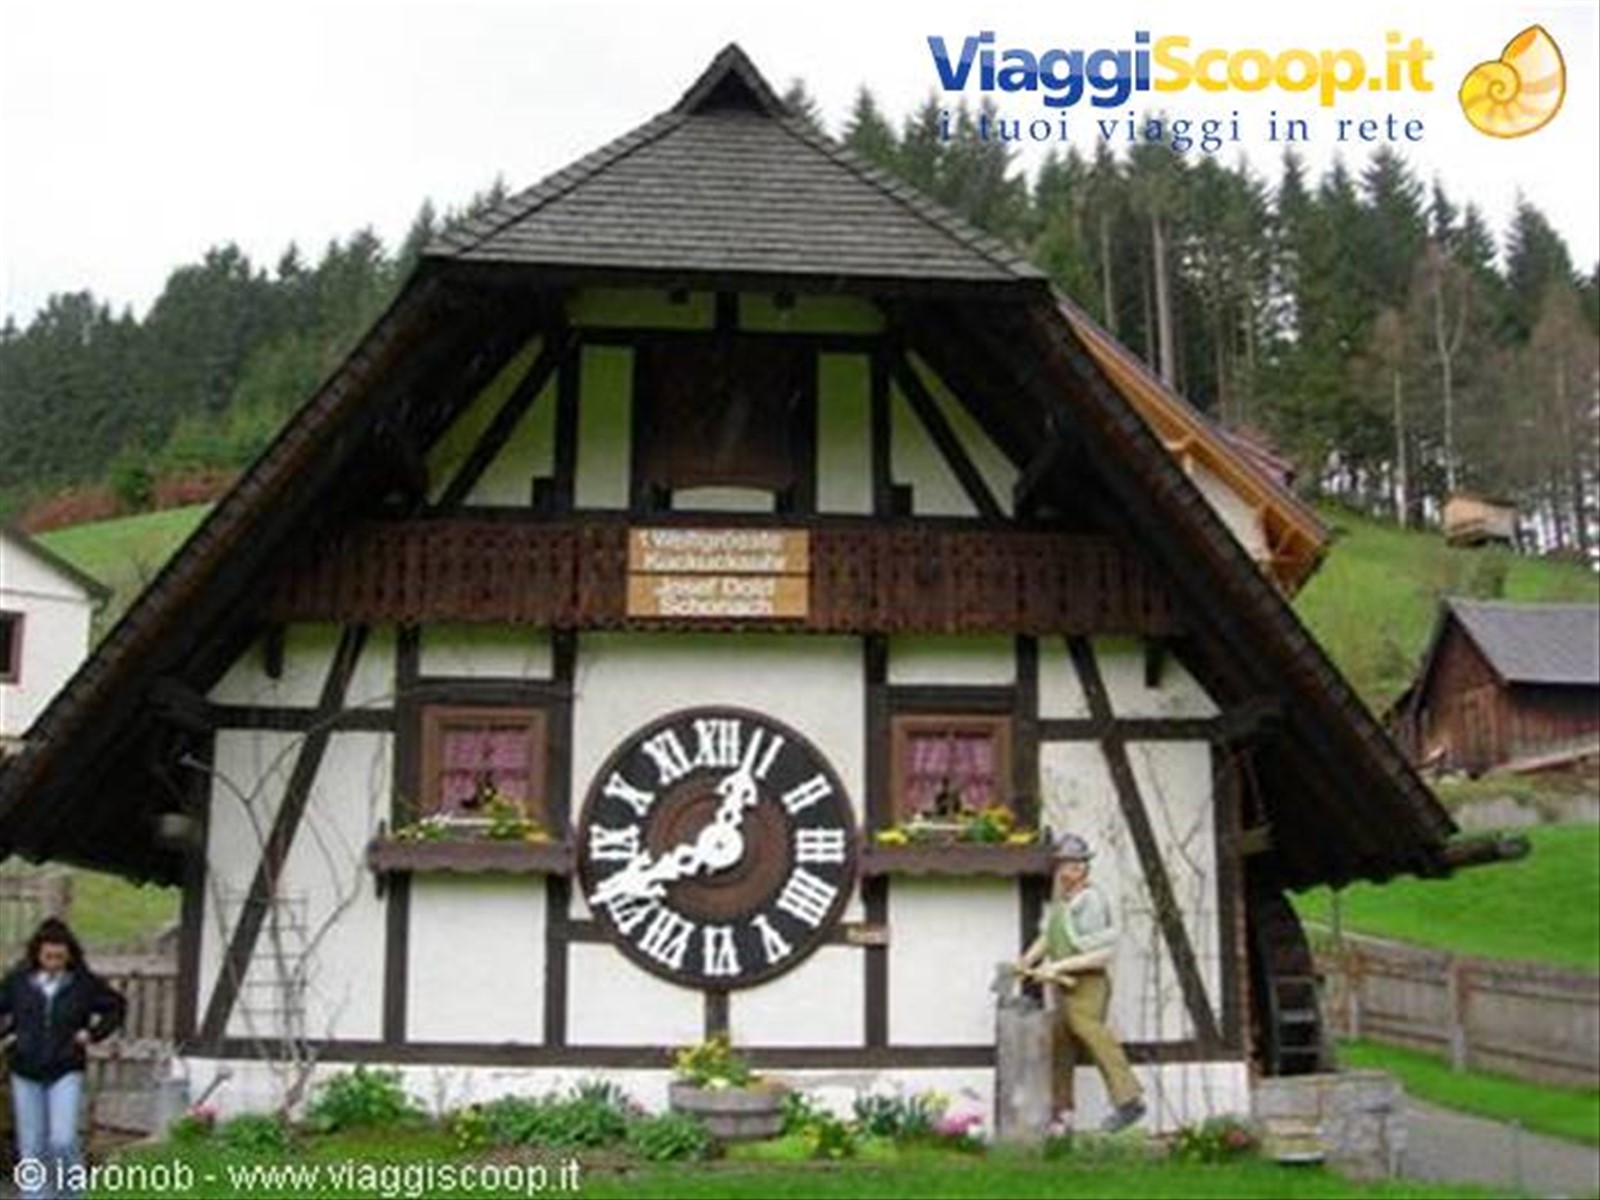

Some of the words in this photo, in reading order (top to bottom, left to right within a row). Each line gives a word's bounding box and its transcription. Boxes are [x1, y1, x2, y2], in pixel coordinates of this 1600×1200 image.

[694, 719, 740, 767] XII
[603, 772, 655, 816] X
[796, 829, 845, 863] III
[703, 926, 741, 975] VI
[751, 914, 792, 964] V
